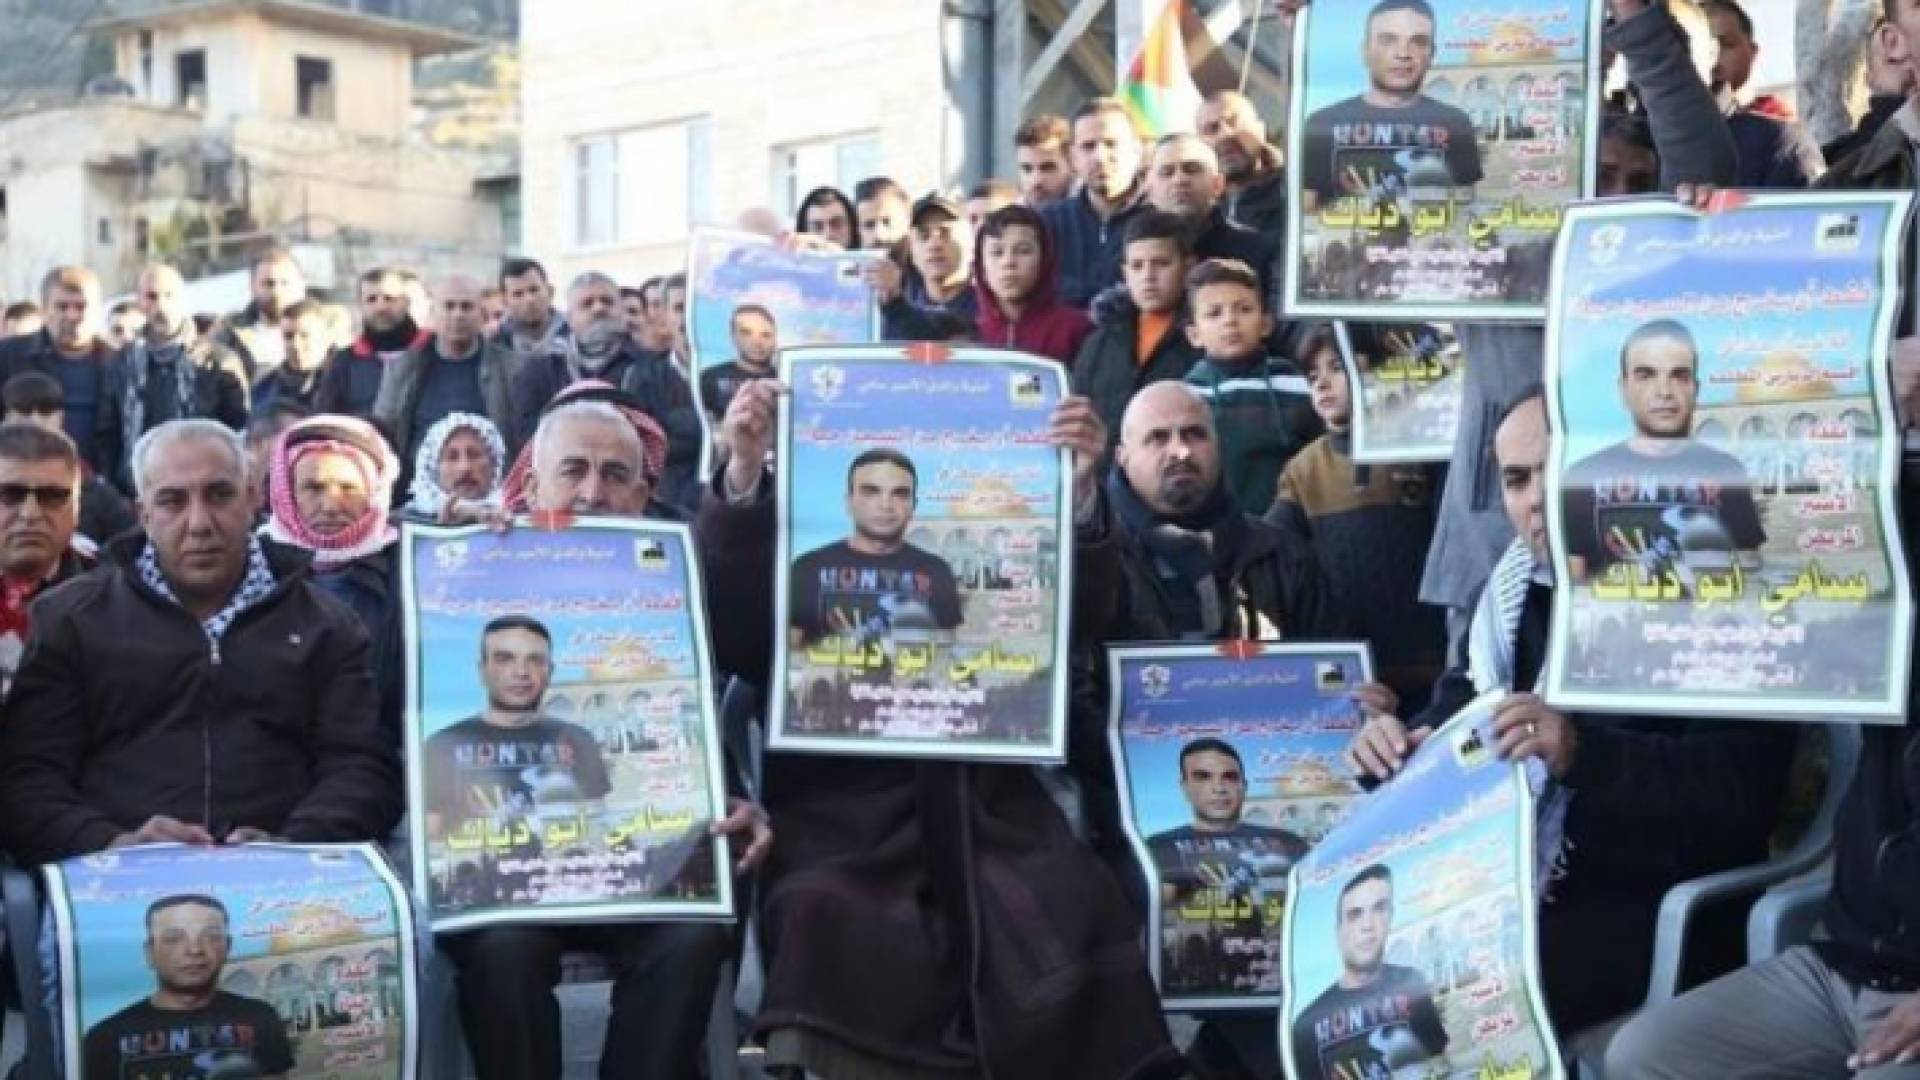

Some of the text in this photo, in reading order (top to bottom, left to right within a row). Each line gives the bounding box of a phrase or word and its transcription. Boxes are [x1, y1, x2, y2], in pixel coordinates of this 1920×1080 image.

[1594, 561, 1682, 611] دياك
[1760, 556, 1868, 625] سامي
[808, 634, 883, 676] دياك
[951, 638, 1038, 690] سامي
